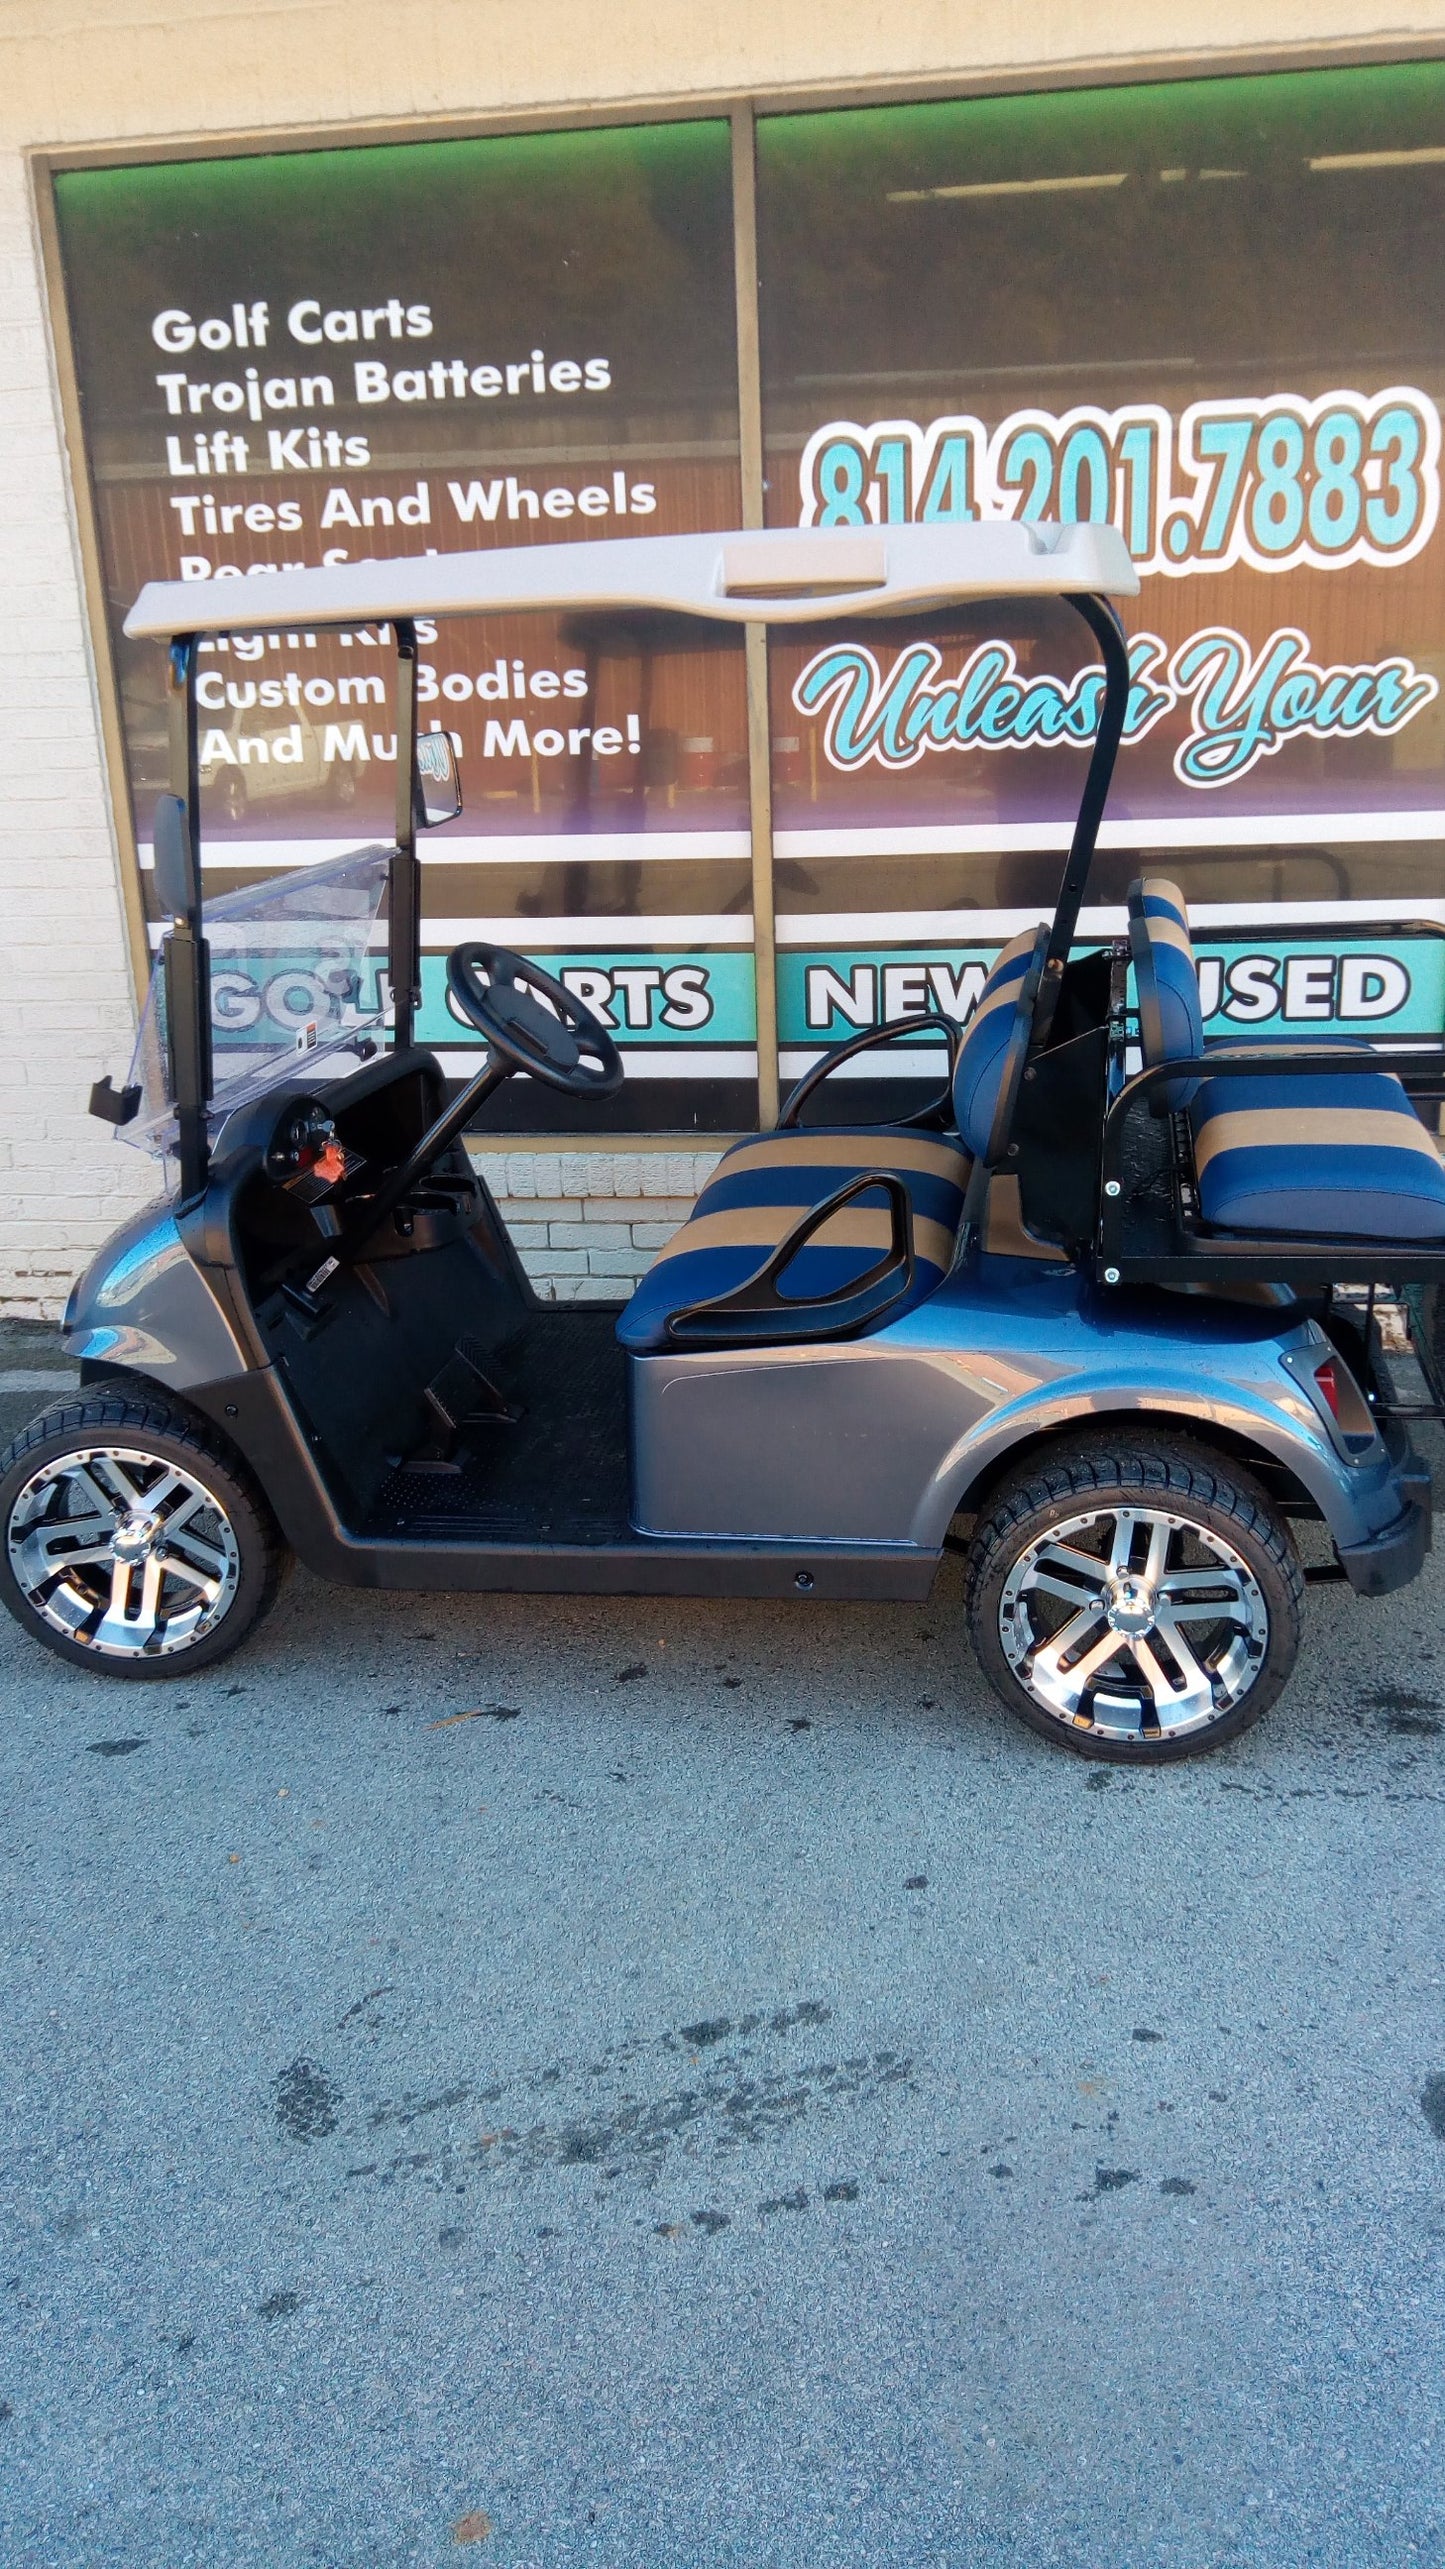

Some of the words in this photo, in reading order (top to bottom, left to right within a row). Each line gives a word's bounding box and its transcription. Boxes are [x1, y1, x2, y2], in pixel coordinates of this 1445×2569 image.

[152, 301, 269, 353] Golf
[288, 299, 433, 345] Carts
[156, 367, 334, 421] Trojan
[354, 349, 611, 403] Batteries
[166, 431, 249, 476] Lift
[268, 426, 371, 470] Kits
[804, 391, 1436, 573] 814201.7883
[170, 494, 303, 536] Tires
[320, 483, 431, 528] And
[447, 471, 657, 523] Wheels
[196, 671, 386, 710] Custom
[416, 659, 588, 702] Bodies
[1170, 628, 1434, 784] Your
[199, 724, 304, 766] And
[484, 714, 641, 757] More!
[806, 961, 989, 1029] NEW
[1196, 954, 1412, 1024] USED
